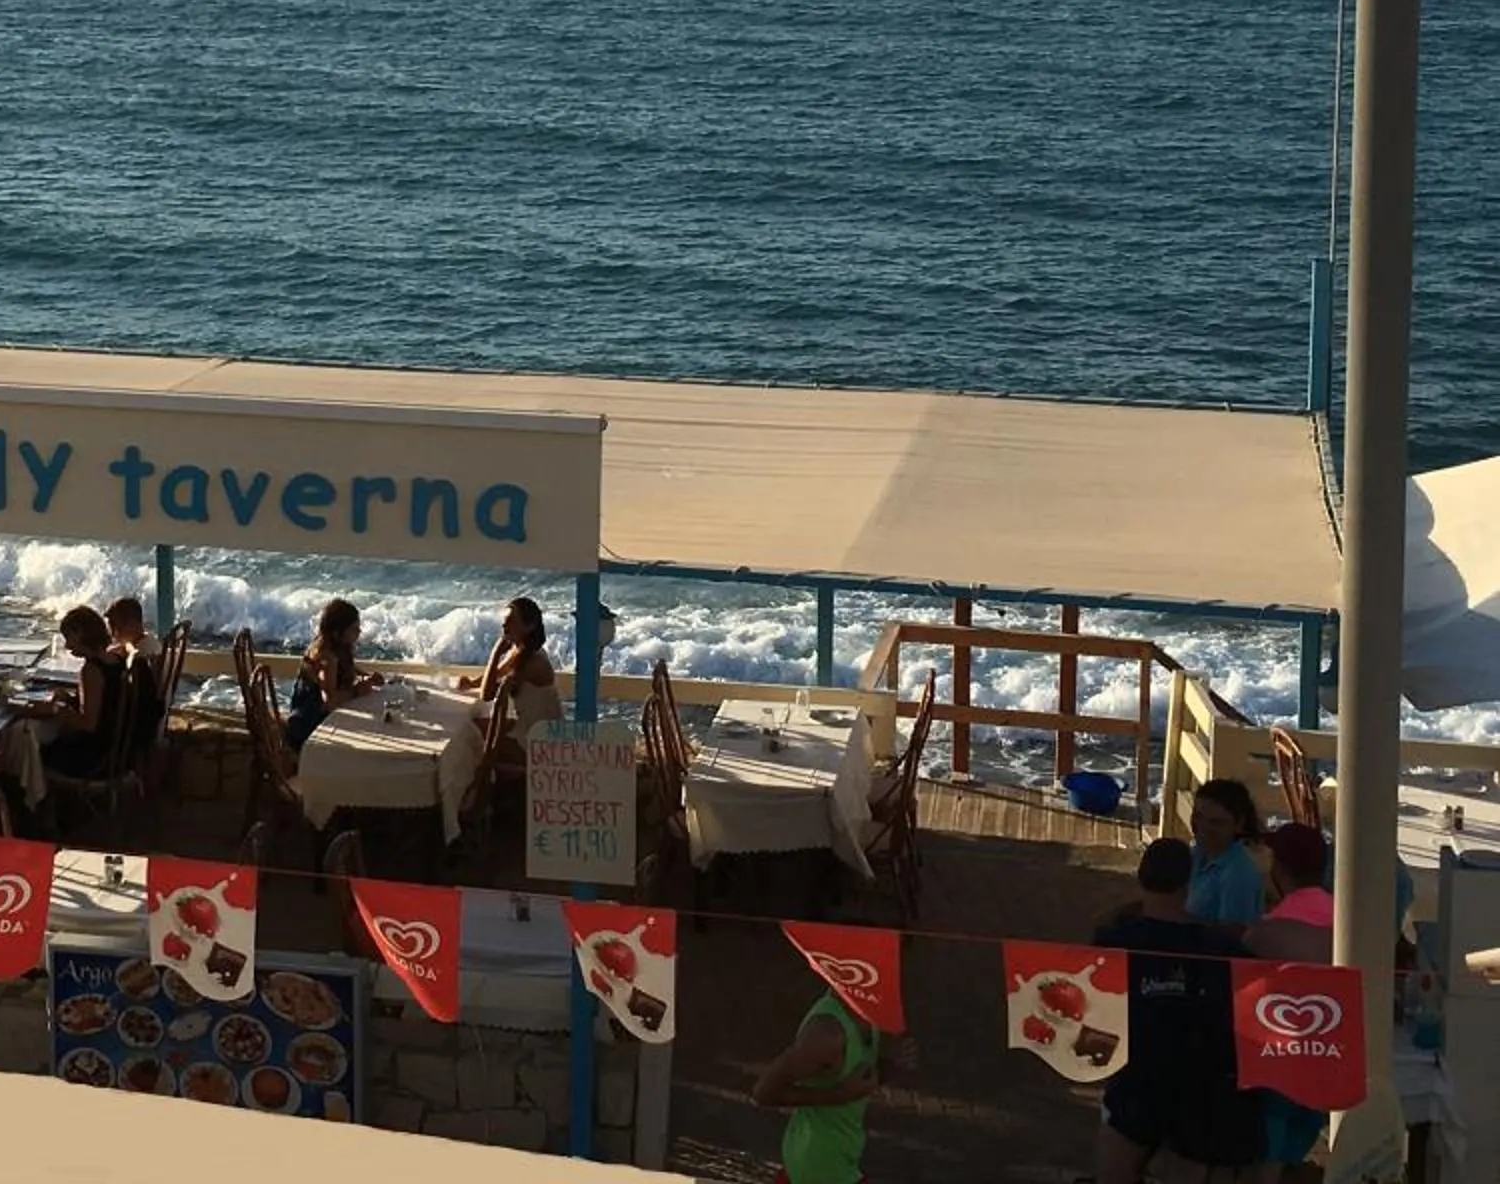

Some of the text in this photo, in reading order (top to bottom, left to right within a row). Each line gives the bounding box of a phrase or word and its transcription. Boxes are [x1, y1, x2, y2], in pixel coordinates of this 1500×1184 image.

[108, 445, 530, 544] taverna
[530, 768, 601, 796] GYROS
[532, 799, 623, 829] DESSERT
[57, 959, 113, 991] Argo
[1260, 1039, 1343, 1060] ALGIDA
